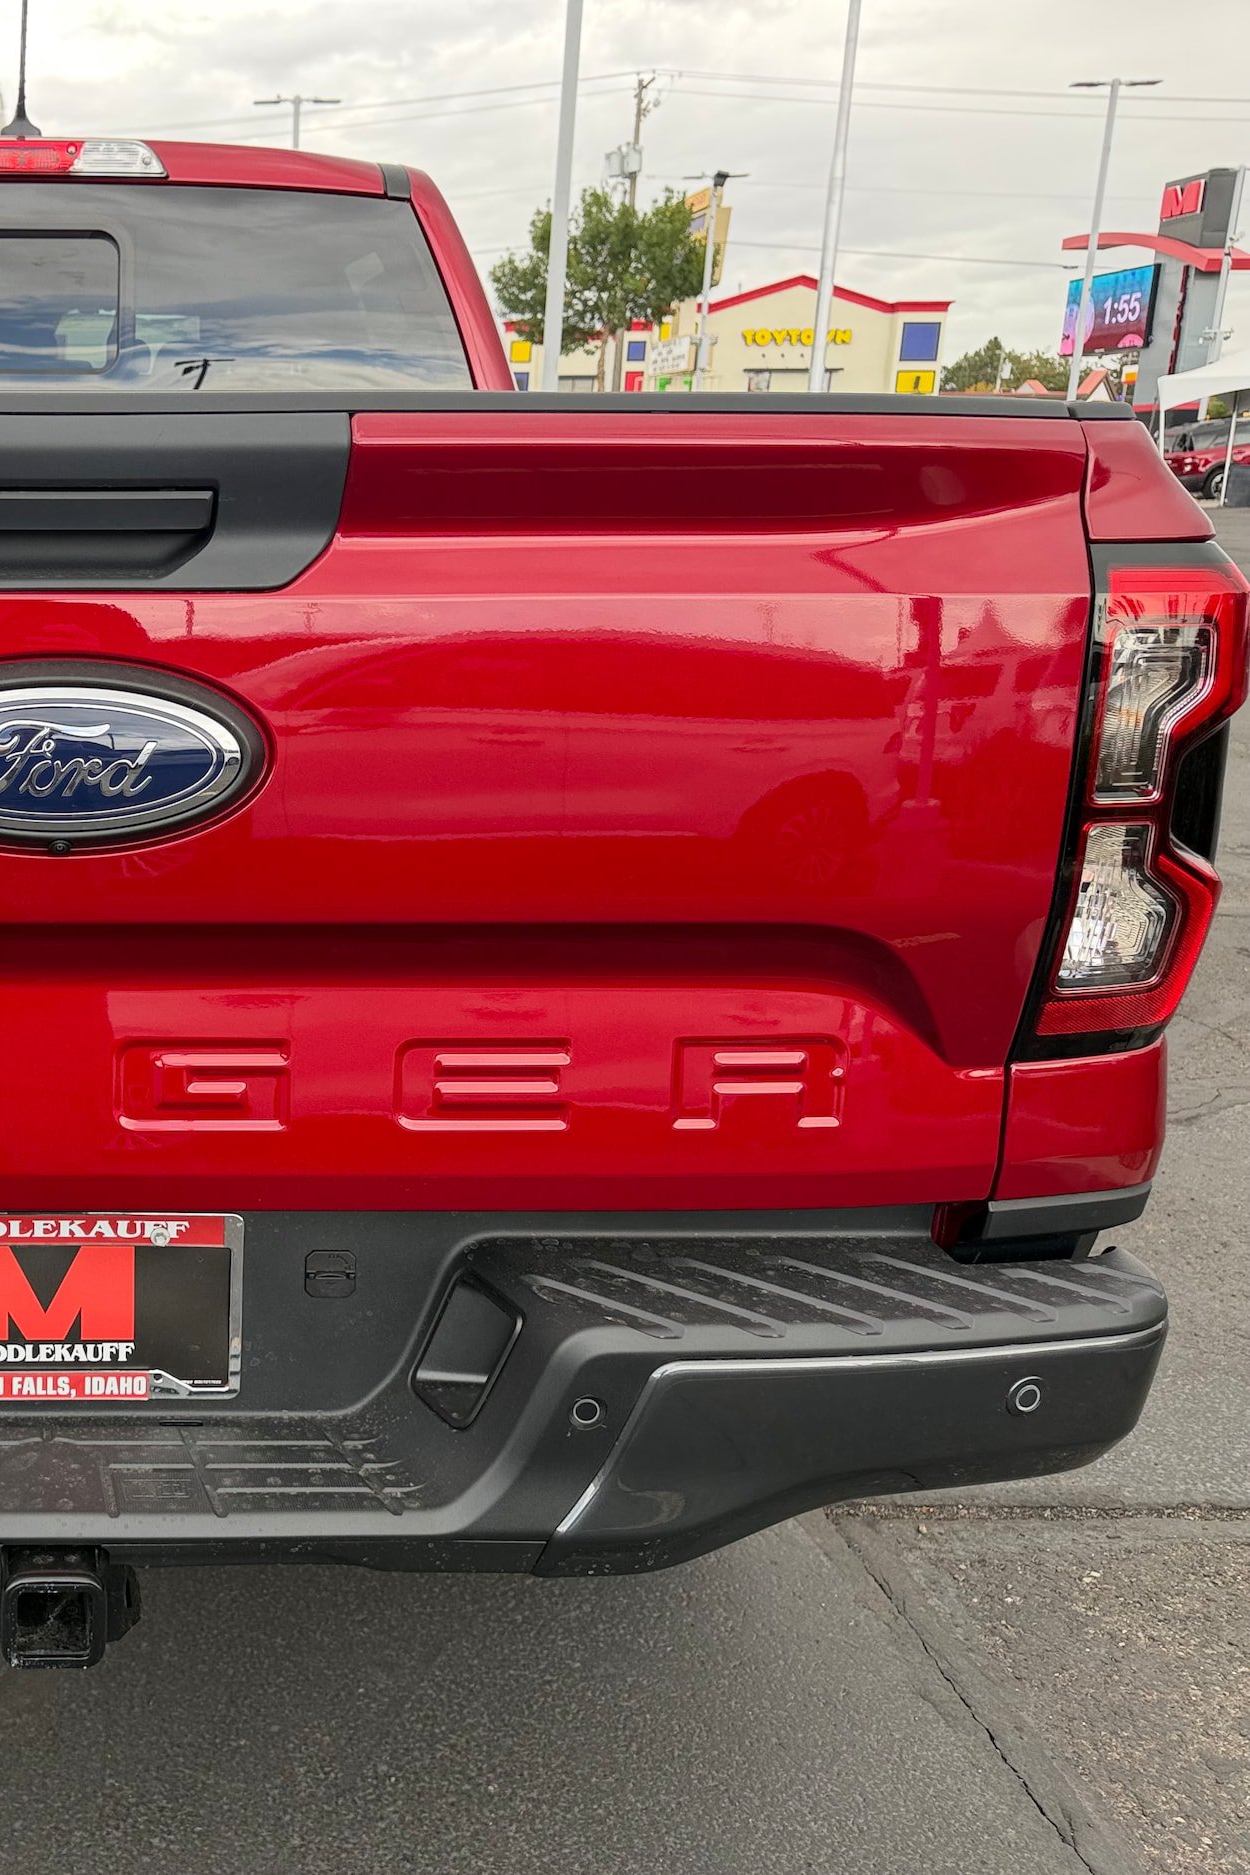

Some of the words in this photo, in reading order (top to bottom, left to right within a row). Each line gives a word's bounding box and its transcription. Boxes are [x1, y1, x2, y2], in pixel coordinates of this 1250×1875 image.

[1103, 292, 1142, 325] 1:55
[12, 1376, 76, 1398] FALLS,
[84, 1376, 147, 1396] IDAHO
